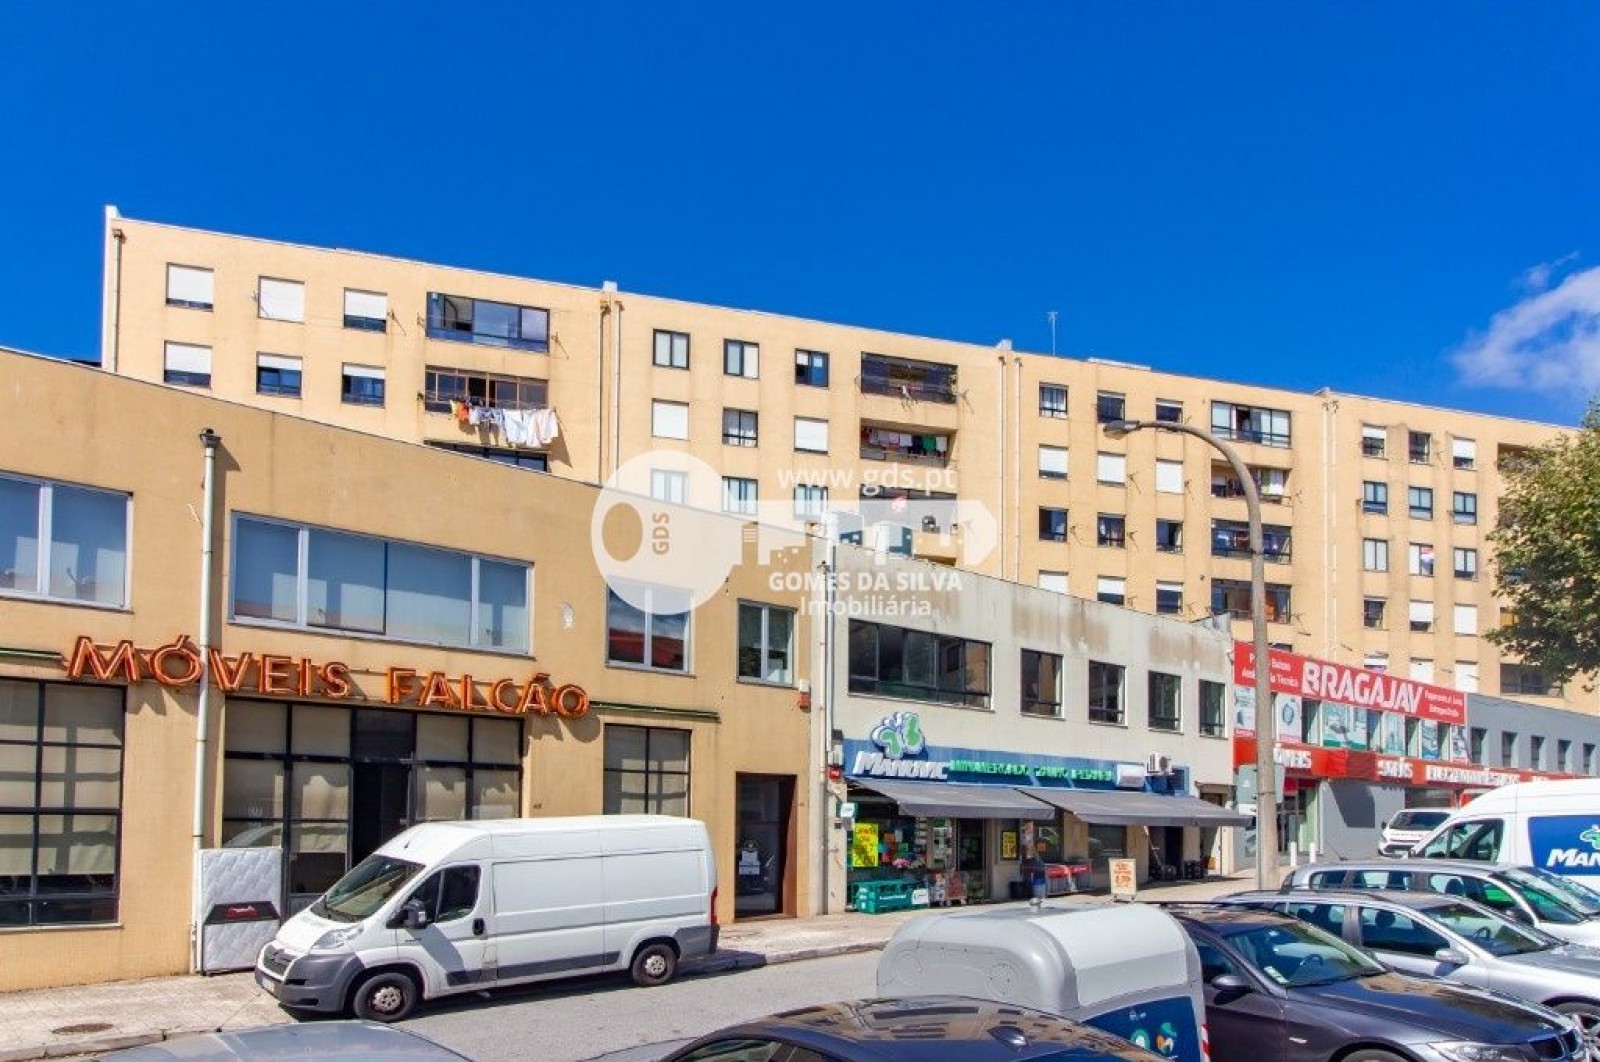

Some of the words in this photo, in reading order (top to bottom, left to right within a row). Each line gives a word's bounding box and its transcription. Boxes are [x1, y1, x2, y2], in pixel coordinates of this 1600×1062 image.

[67, 634, 351, 699] MÓVEIS
[384, 666, 590, 718] FALCÃO
[1301, 661, 1423, 714] BRAGAJAV
